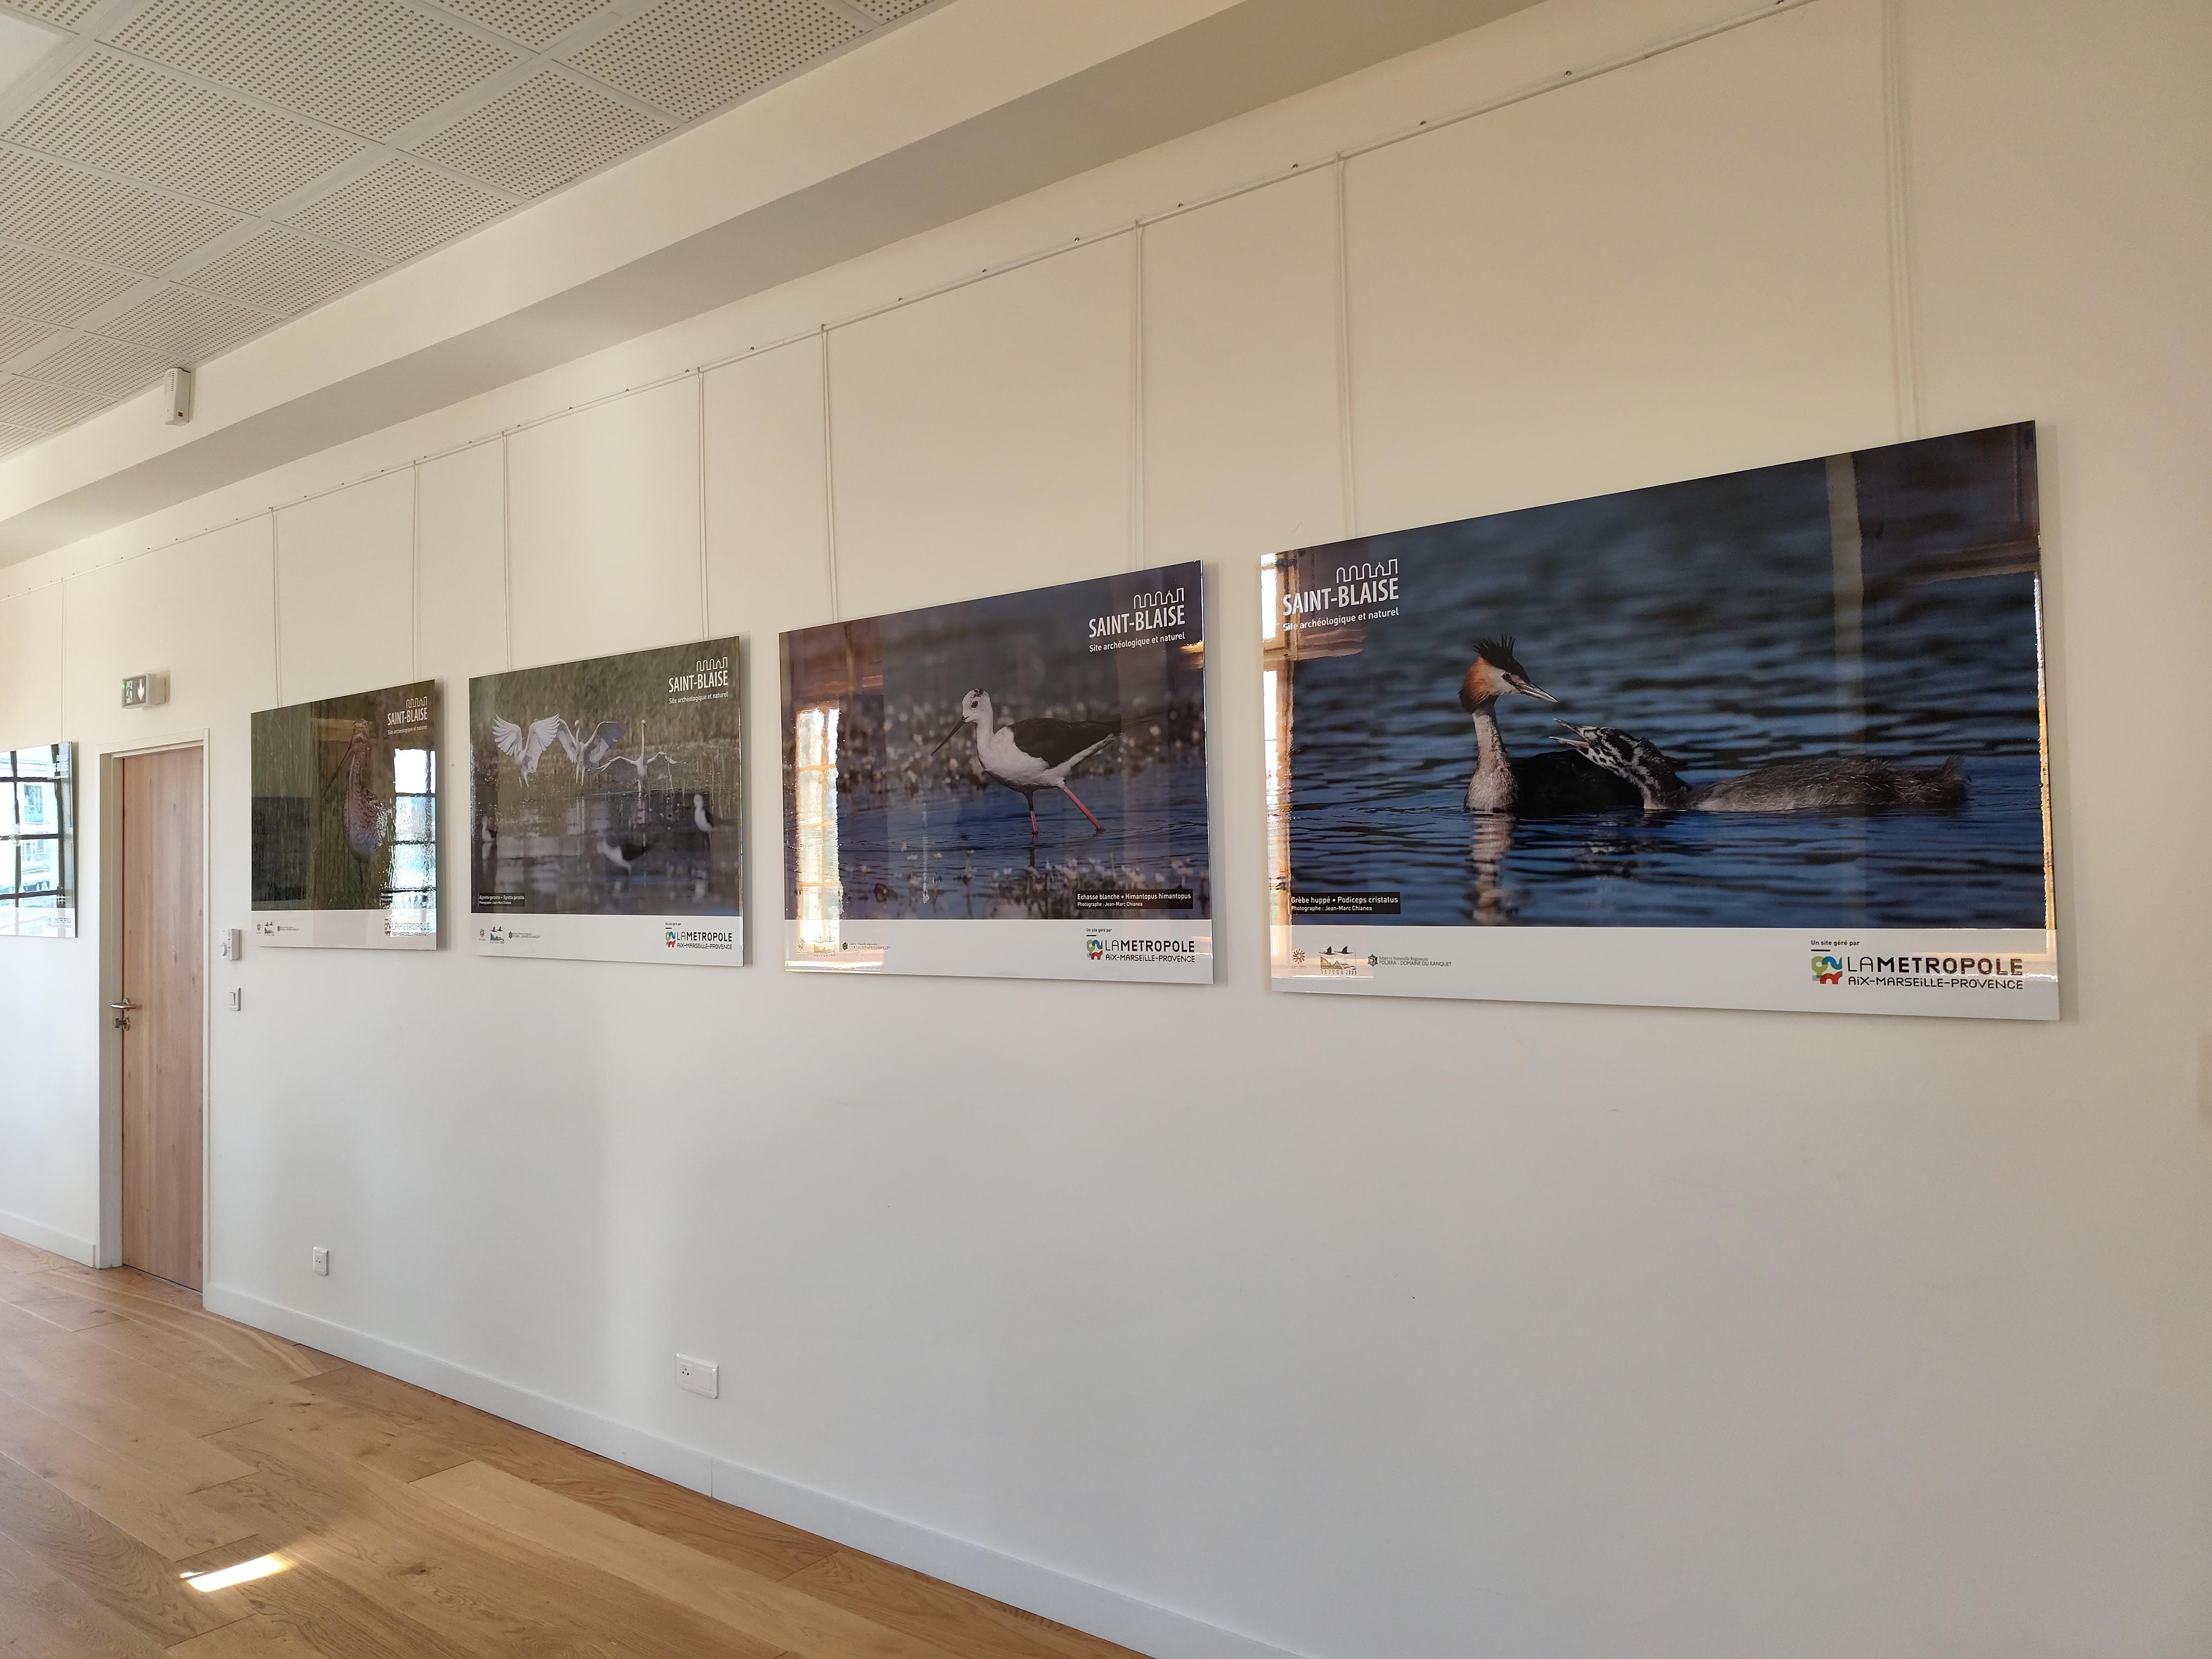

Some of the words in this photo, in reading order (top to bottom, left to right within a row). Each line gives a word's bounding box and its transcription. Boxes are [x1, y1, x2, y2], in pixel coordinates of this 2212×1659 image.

[1282, 577, 1399, 616] SAINT-BLAISE
[1089, 605, 1185, 638] SAINT-BLAISE
[1283, 623, 1297, 631] Site
[1300, 615, 1356, 629] archéologique
[1358, 613, 1366, 621] et
[1368, 607, 1399, 619] naturel
[1089, 644, 1102, 652] Site
[1103, 638, 1149, 650] archéologique
[1160, 632, 1185, 642] naturel
[668, 670, 728, 693] SAINT-BLAISE
[387, 707, 428, 726] SAINT-BLAISE
[1159, 892, 1191, 901] himantopus
[1311, 896, 1330, 905] huppé
[1338, 896, 1367, 904] Podiceps
